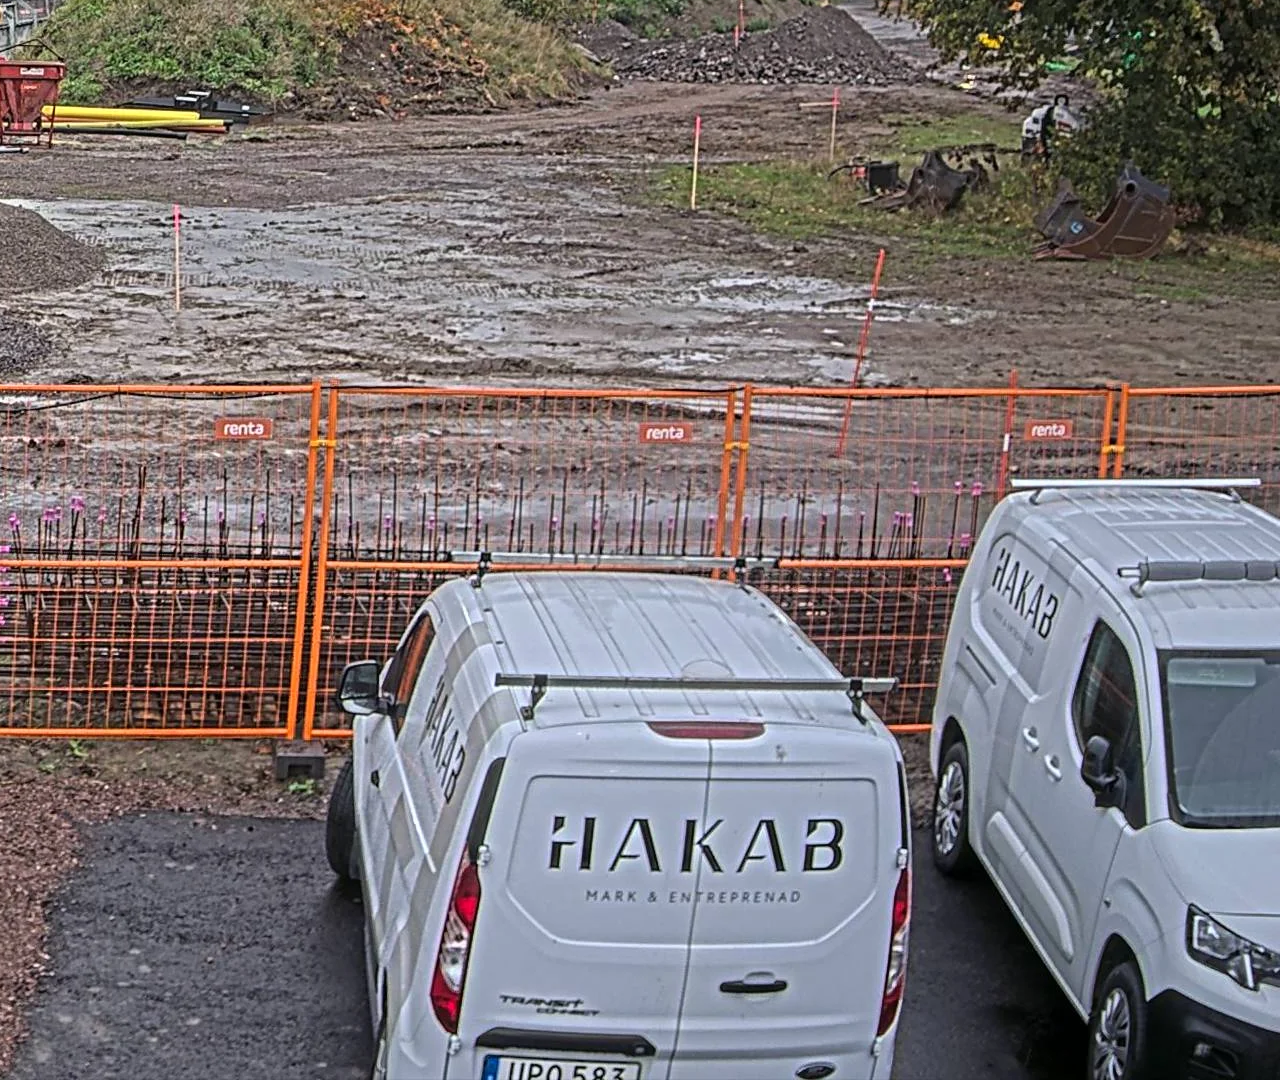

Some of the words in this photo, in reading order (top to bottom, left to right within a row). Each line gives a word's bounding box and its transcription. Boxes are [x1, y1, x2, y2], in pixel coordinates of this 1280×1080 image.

[224, 421, 264, 435] renta
[646, 426, 684, 439] renta
[1032, 423, 1065, 437] renta
[992, 547, 1058, 639] HAKAB
[417, 675, 465, 804] HAKAB
[549, 816, 845, 873] HAKAB
[585, 890, 637, 903] MARK
[647, 891, 657, 903] &
[668, 891, 801, 904] ENTREPRENAD
